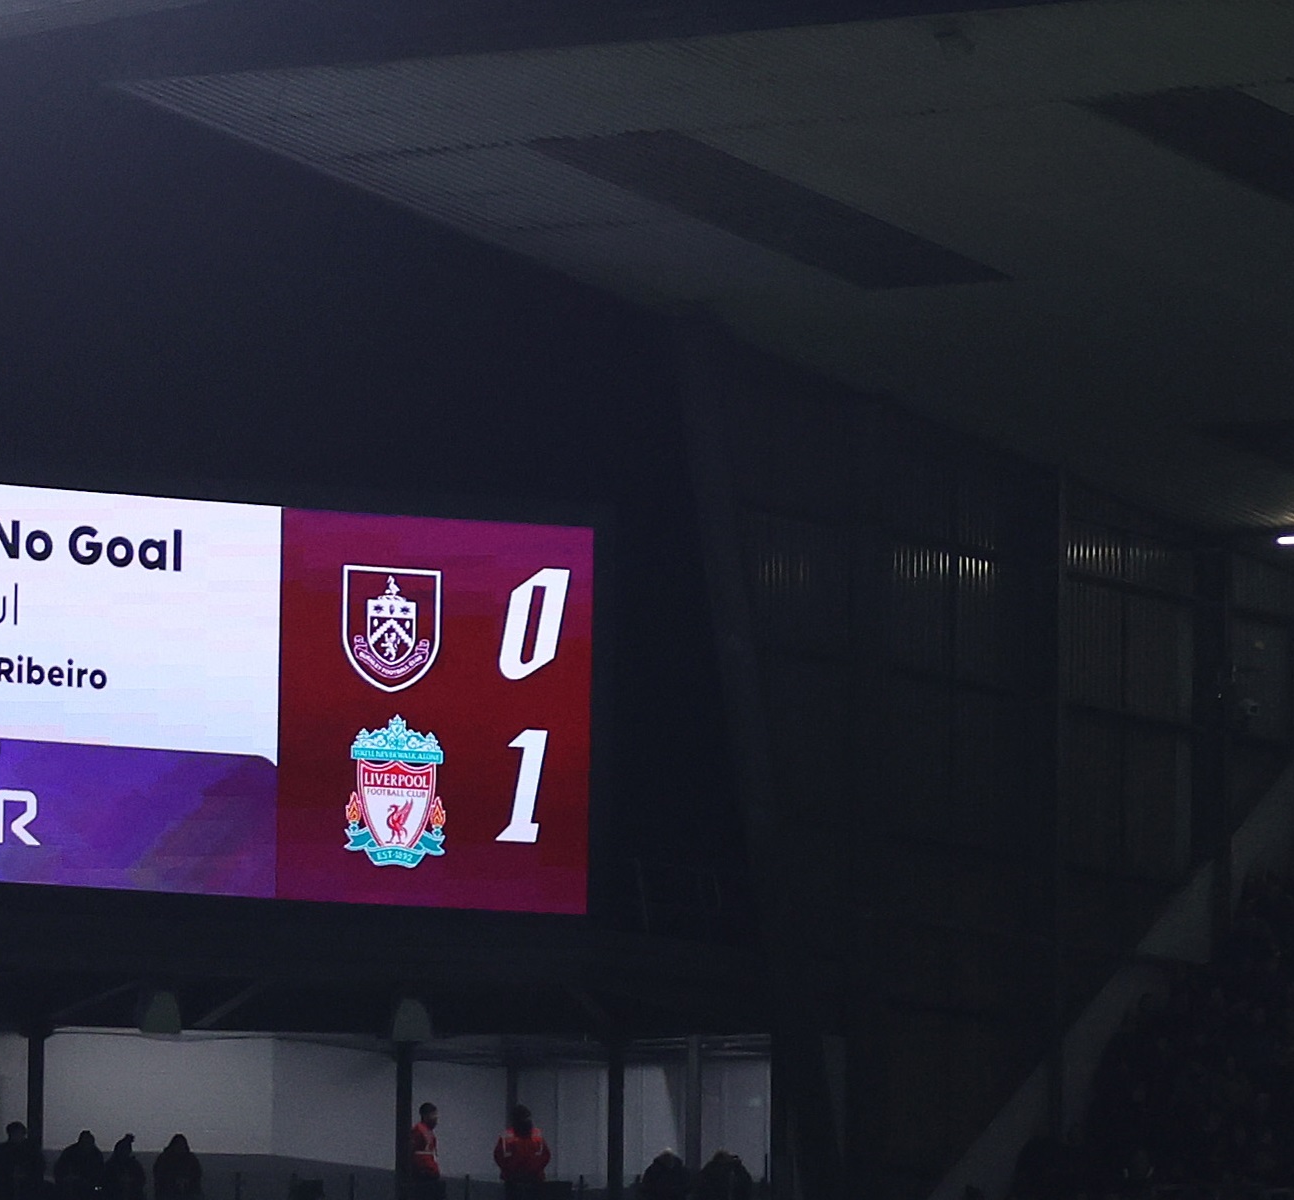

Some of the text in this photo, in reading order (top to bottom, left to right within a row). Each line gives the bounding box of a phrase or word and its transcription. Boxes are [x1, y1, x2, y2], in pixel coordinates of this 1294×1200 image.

[68, 525, 182, 572] Goal
[499, 568, 571, 680] 0
[364, 771, 429, 788] LIVERPOOL
[366, 787, 426, 799] FOOTBALL CLUB
[495, 729, 548, 843] 1
